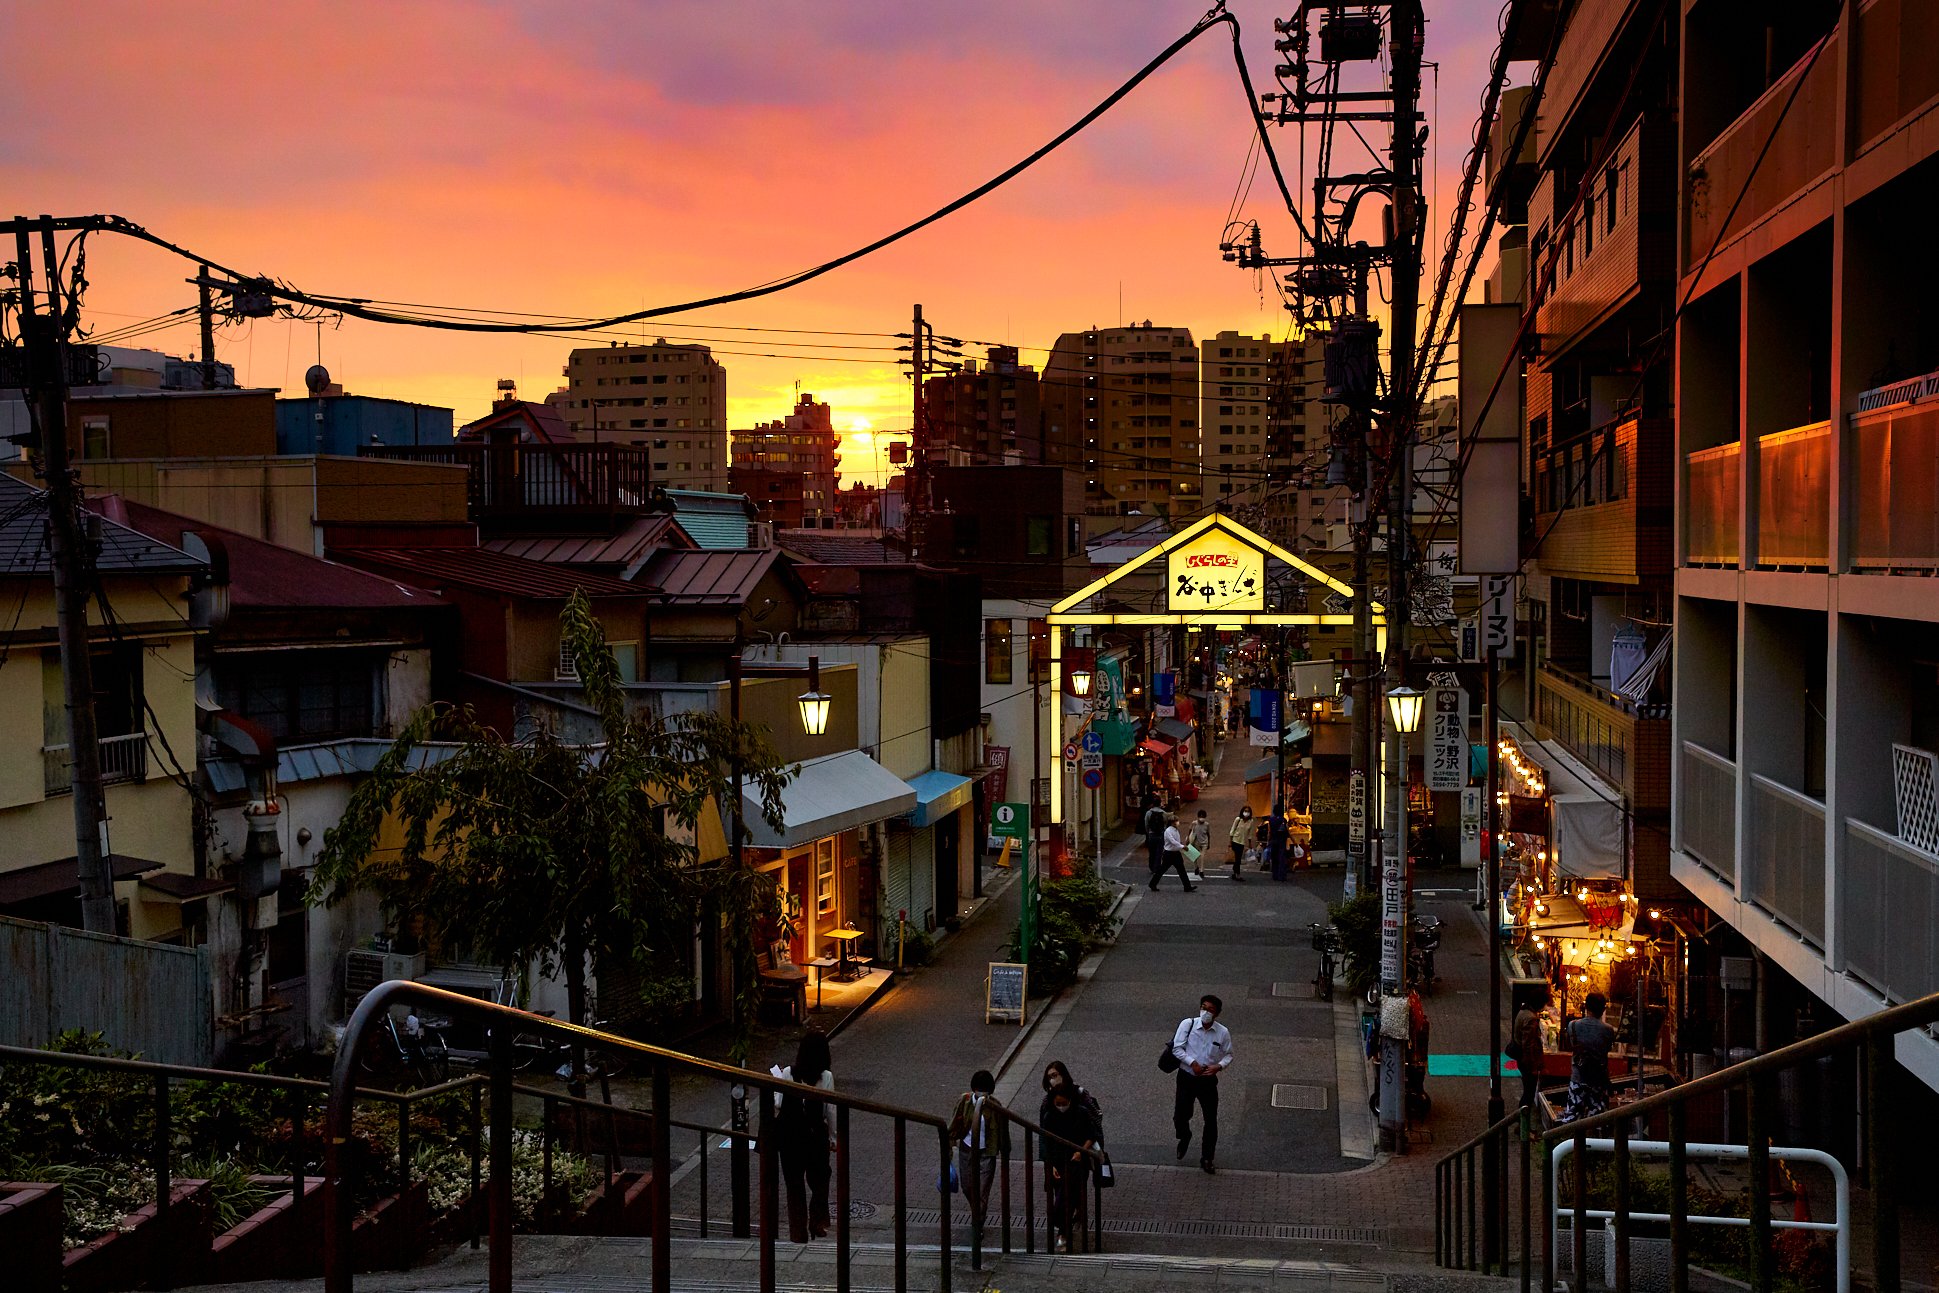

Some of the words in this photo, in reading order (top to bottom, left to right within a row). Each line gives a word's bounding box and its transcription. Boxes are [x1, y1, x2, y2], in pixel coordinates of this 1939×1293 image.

[1186, 550, 1239, 568] ひぐらしの里
[1175, 564, 1258, 604] 谷中ぎんざ
[1433, 714, 1446, 769] クリニック
[1446, 714, 1460, 770] 動物・野沢
